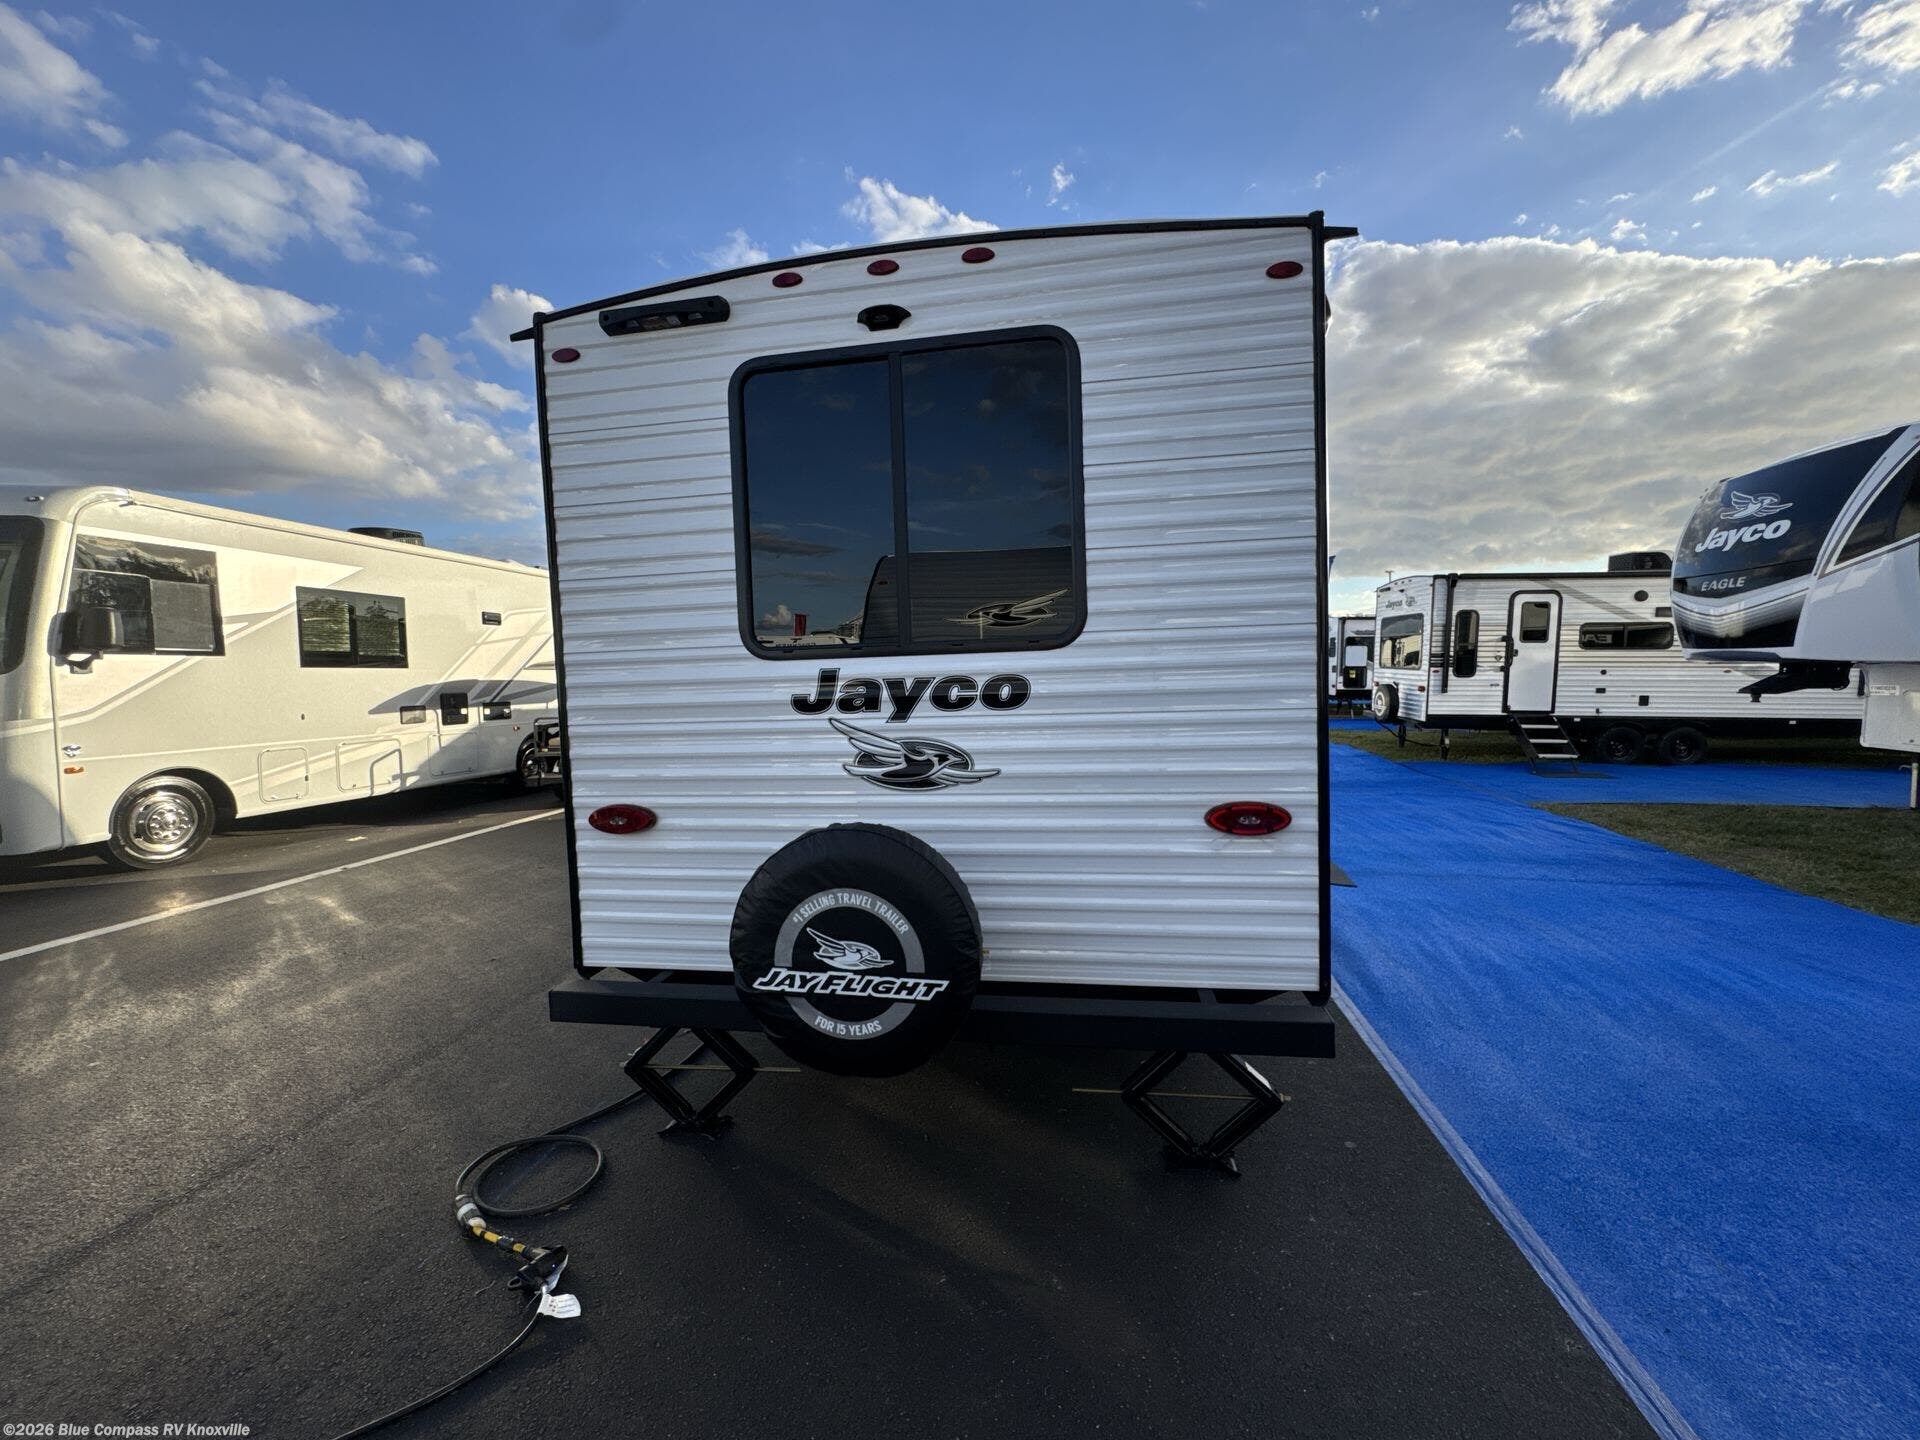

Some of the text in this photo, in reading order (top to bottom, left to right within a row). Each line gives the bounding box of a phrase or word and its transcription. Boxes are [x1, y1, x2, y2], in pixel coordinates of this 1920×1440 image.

[1695, 519, 1792, 553] Jayco
[1701, 576, 1747, 591] EAGLE
[790, 667, 1032, 723] Jayco
[800, 894, 836, 918] SELLING
[837, 892, 872, 908] TRAVEL
[874, 901, 909, 934] TRAILER
[814, 1015, 882, 1036] FOR 15 YEARS
